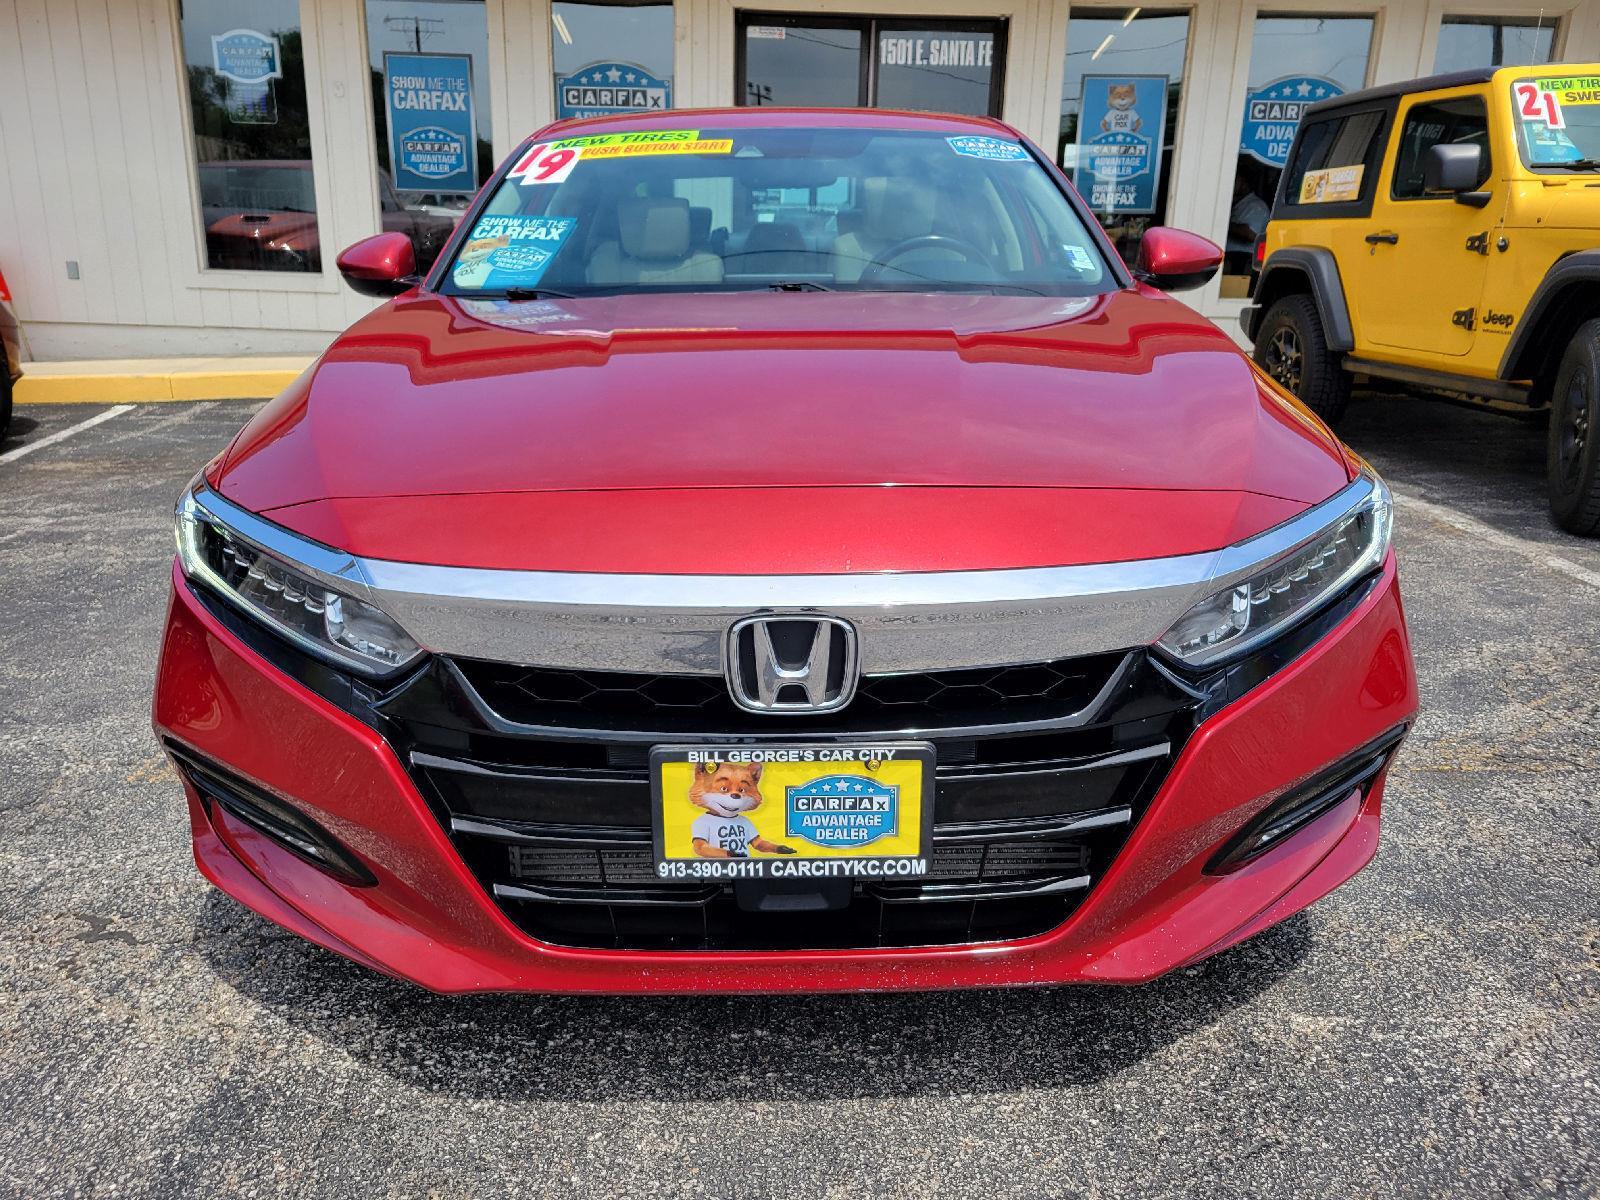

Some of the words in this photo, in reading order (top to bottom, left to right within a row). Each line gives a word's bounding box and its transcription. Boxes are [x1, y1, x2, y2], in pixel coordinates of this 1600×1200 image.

[880, 39, 912, 65] 1501
[915, 39, 928, 65] E.
[929, 40, 975, 66] SANTA
[977, 40, 993, 66] FE
[392, 76, 426, 90] SHOW
[428, 77, 444, 90] ME
[448, 78, 465, 91] THE
[1540, 80, 1572, 90] NEW
[393, 90, 467, 111] CARFAX
[567, 90, 660, 108] CARFAX
[1517, 84, 1560, 125] 21
[1254, 124, 1298, 140] ADVA
[407, 142, 459, 153] CARFAX
[554, 136, 612, 149] NEW
[619, 132, 690, 143] TIRES
[582, 146, 621, 157] PUSH
[624, 142, 679, 153] BUTTON
[682, 141, 728, 151] START
[1267, 142, 1292, 157] DE
[410, 153, 457, 165] ADVANTAGE
[513, 144, 576, 181] 19
[418, 163, 450, 173] DEALER
[1091, 192, 1136, 205] CARFAX
[480, 217, 522, 227] SHOW
[523, 219, 544, 229] ME
[547, 220, 569, 229] THE
[473, 226, 563, 240] CARFAX
[1482, 309, 1515, 328] Jeep
[687, 751, 725, 763] BILL
[728, 750, 814, 763] GEORGE'S
[820, 750, 857, 762] CAR
[860, 749, 896, 762] CITY
[797, 799, 887, 811] CARFAX
[802, 815, 882, 827] ADVANTAGE
[717, 825, 745, 838] CAR
[816, 828, 868, 840] DEALER
[719, 838, 747, 851] FOX
[659, 862, 764, 877] 913-390-0111
[770, 860, 926, 876] CARCITYKC.COM
